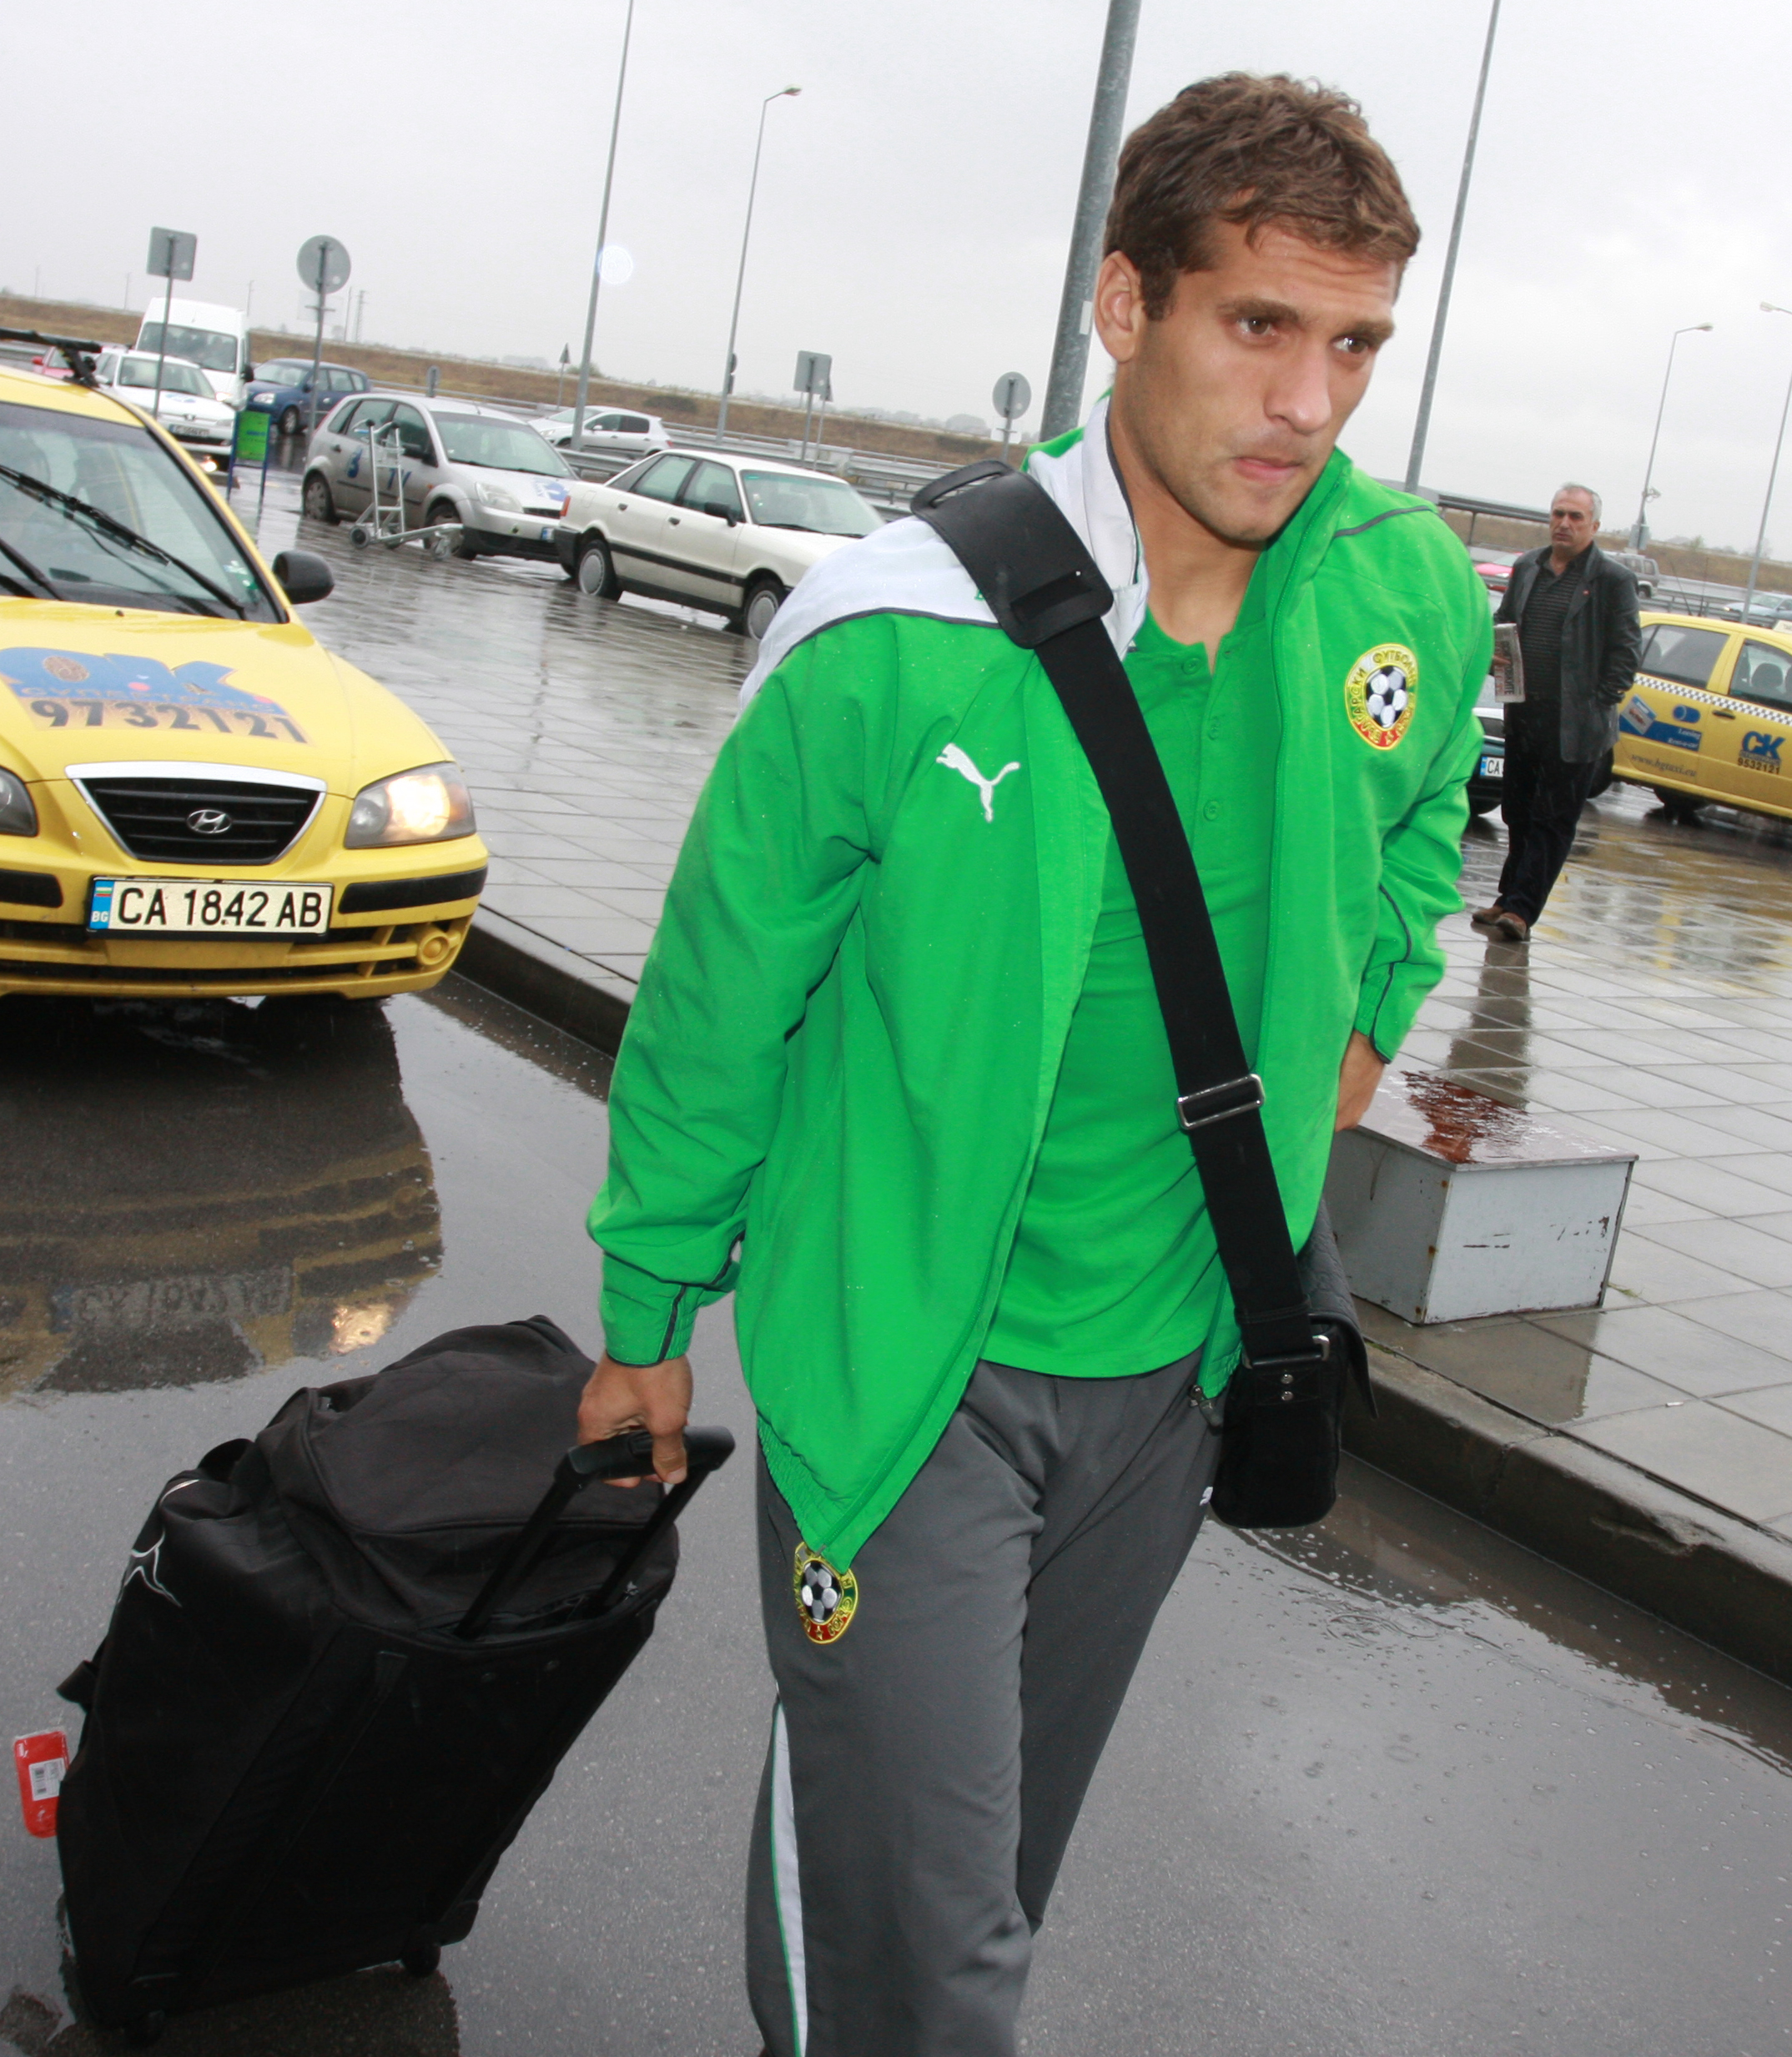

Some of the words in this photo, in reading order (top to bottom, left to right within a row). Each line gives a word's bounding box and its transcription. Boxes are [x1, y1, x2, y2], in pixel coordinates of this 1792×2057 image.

[30, 699, 308, 744] 9732121
[1487, 760, 1500, 775] CA
[1738, 757, 1781, 775] 9532121
[91, 910, 108, 923] BG
[118, 888, 167, 925] CA
[275, 892, 322, 928] AB
